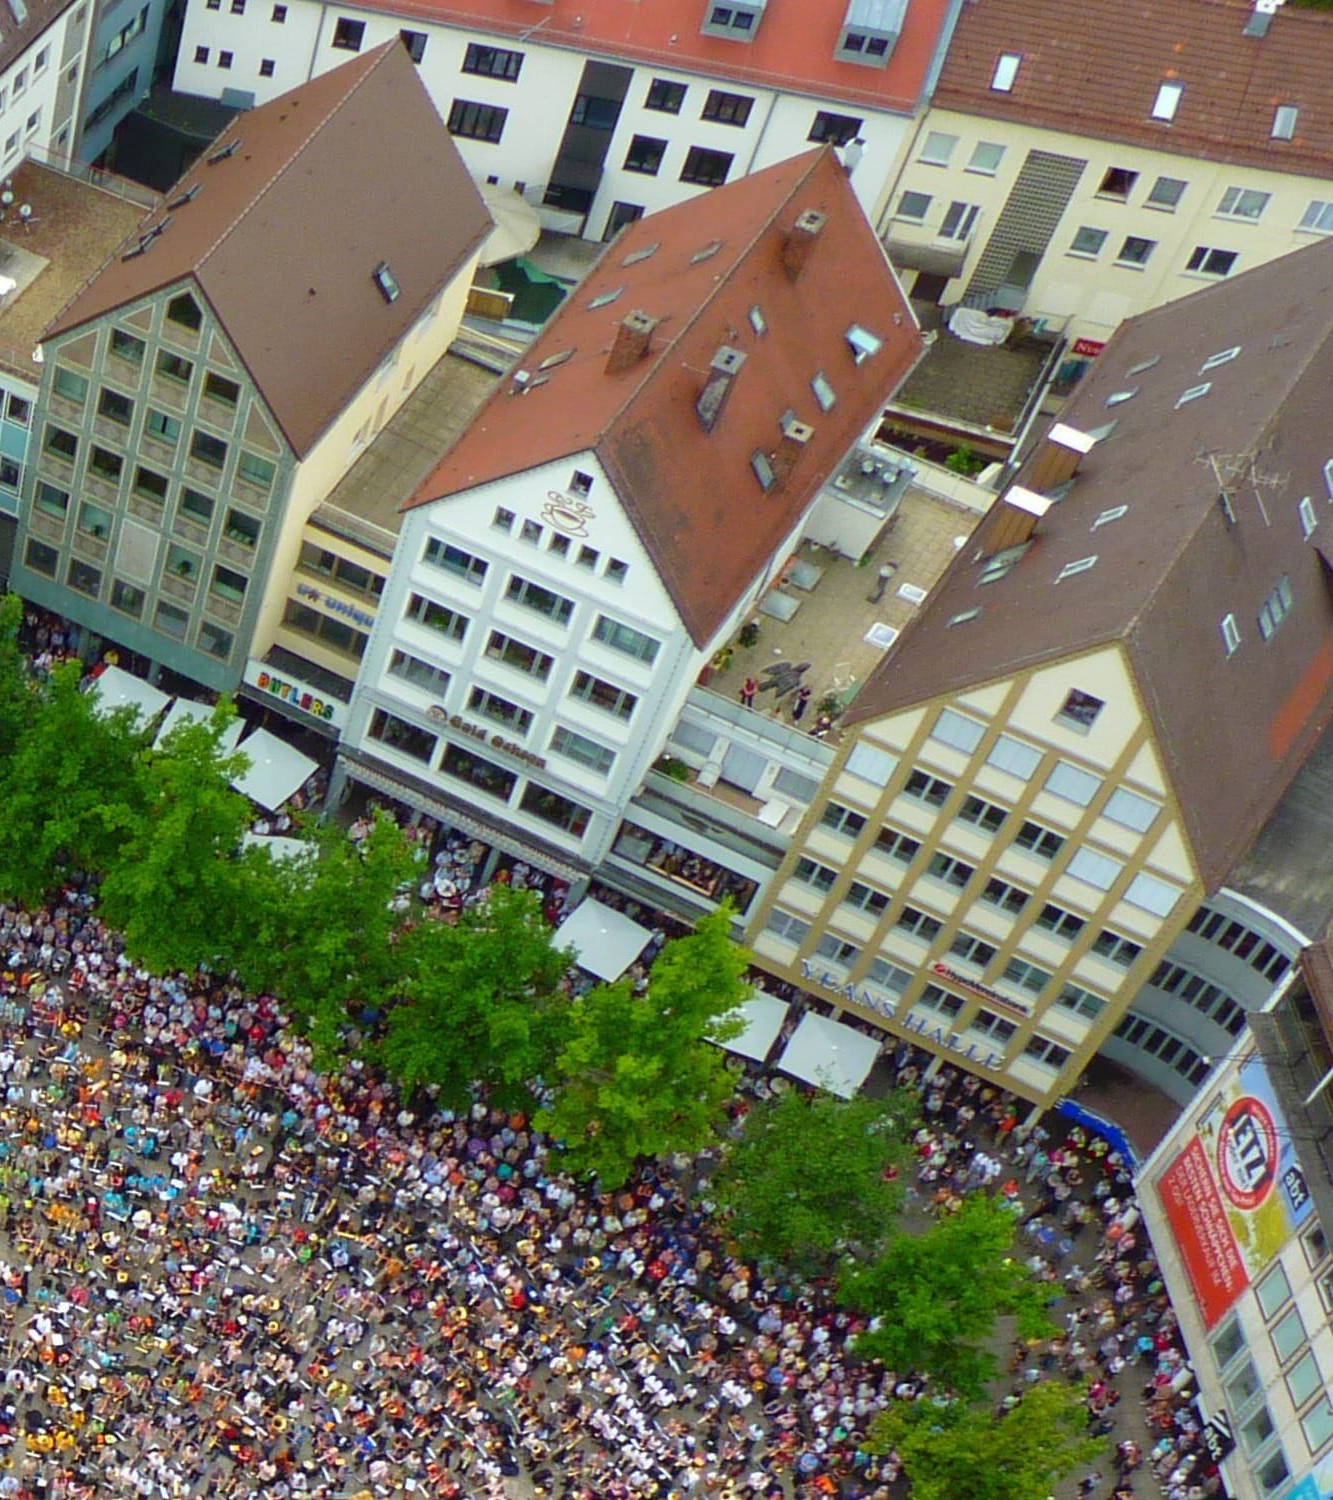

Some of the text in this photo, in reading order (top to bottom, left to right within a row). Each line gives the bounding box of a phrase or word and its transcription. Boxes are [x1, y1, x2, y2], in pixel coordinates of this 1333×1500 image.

[257, 670, 335, 720] BUTLERS
[800, 958, 1006, 1072] YEANS HALLE
[1286, 1170, 1307, 1211] abt
[1204, 1426, 1222, 1461] abt
